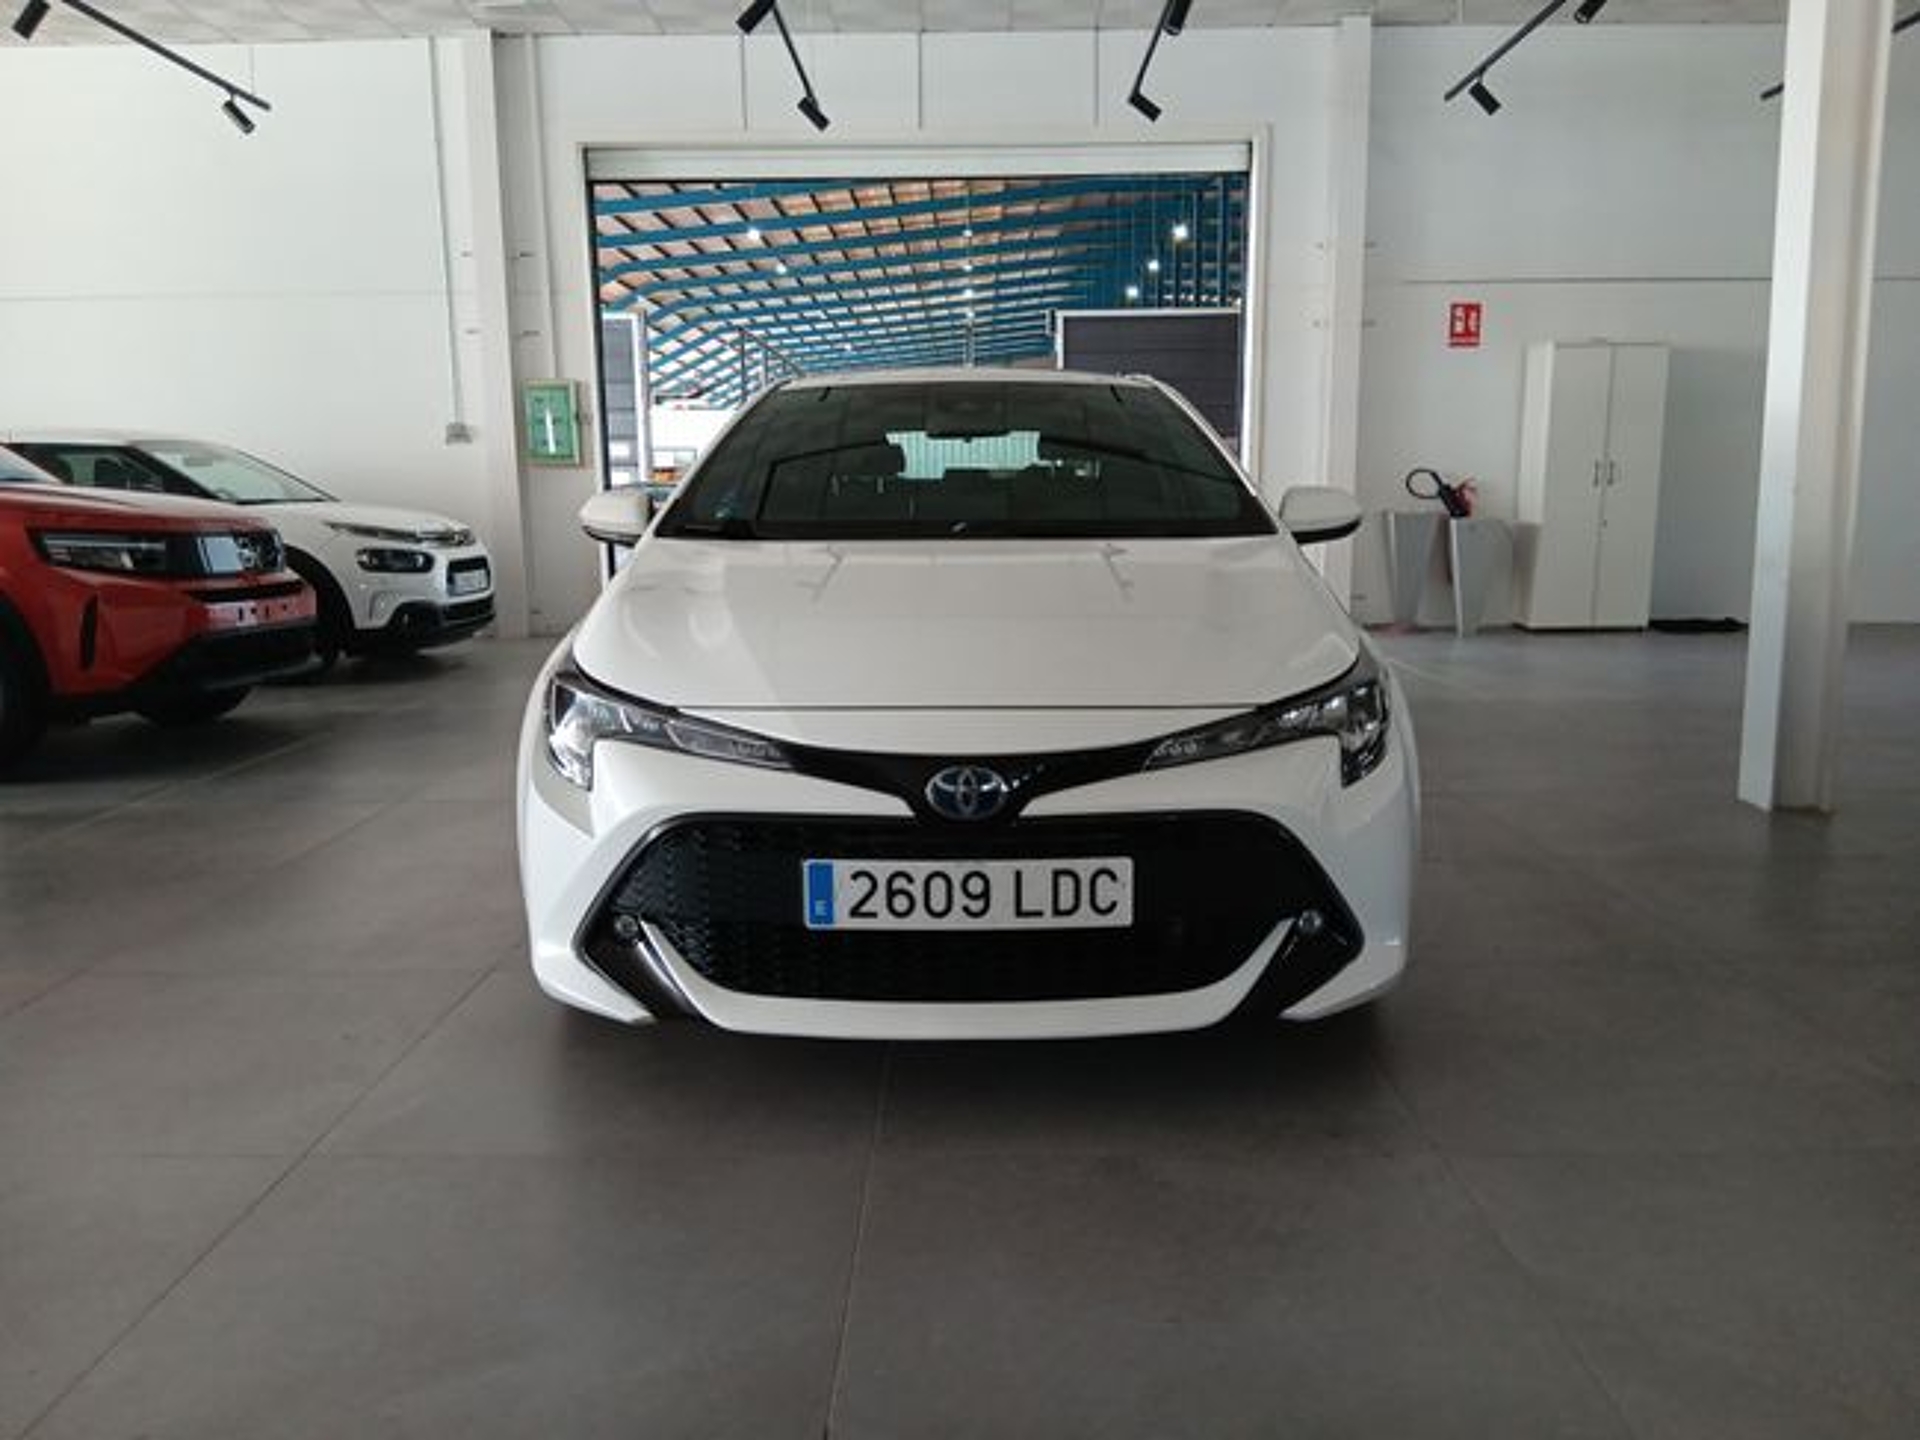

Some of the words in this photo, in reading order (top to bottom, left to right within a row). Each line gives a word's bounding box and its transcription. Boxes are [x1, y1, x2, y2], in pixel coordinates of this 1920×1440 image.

[815, 900, 828, 916] E
[849, 869, 991, 919] 2609
[1014, 867, 1118, 918] LDC
